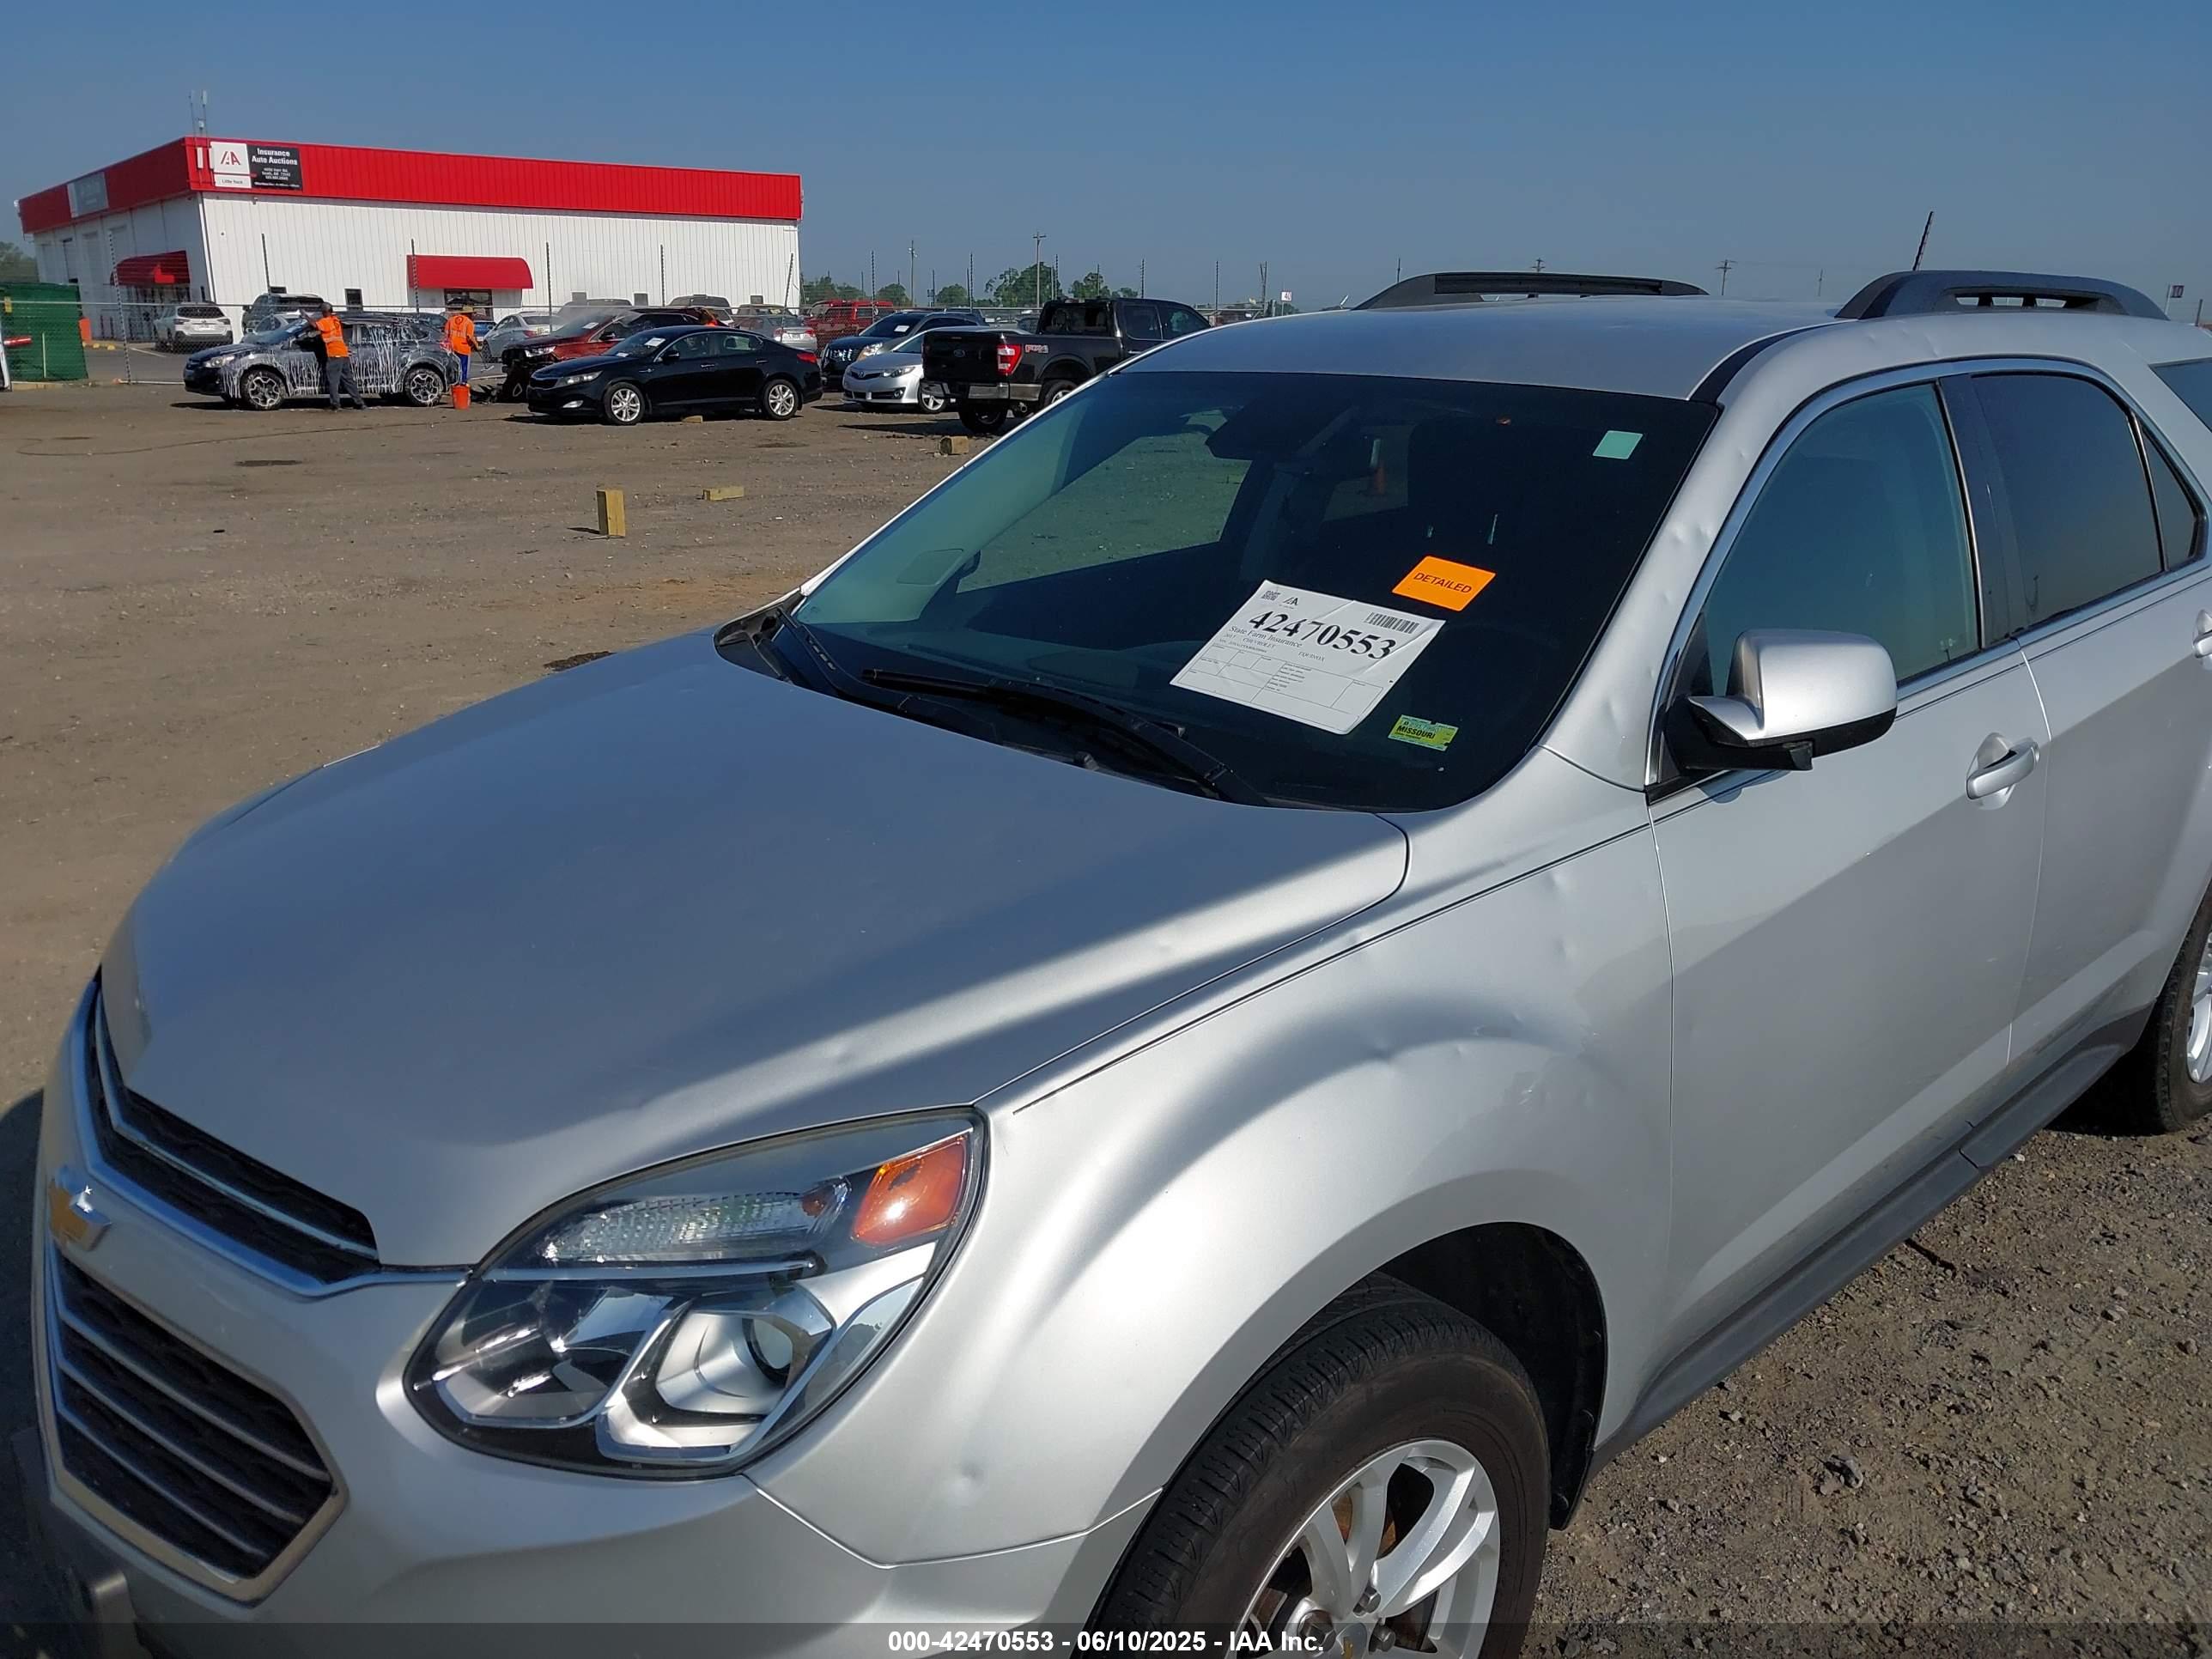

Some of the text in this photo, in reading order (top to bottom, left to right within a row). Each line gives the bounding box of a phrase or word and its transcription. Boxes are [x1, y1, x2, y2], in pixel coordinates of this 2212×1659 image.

[257, 148, 290, 156] Insurance
[269, 156, 298, 165] Auctions
[1413, 573, 1472, 593] DETAILED
[1229, 625, 1248, 635] State
[1247, 629, 1267, 641] Farm
[1267, 635, 1303, 648] Insurance
[1243, 637, 1276, 649] CHEVROLET
[1249, 610, 1397, 662] 42470553
[1396, 725, 1436, 739] MISSOURI
